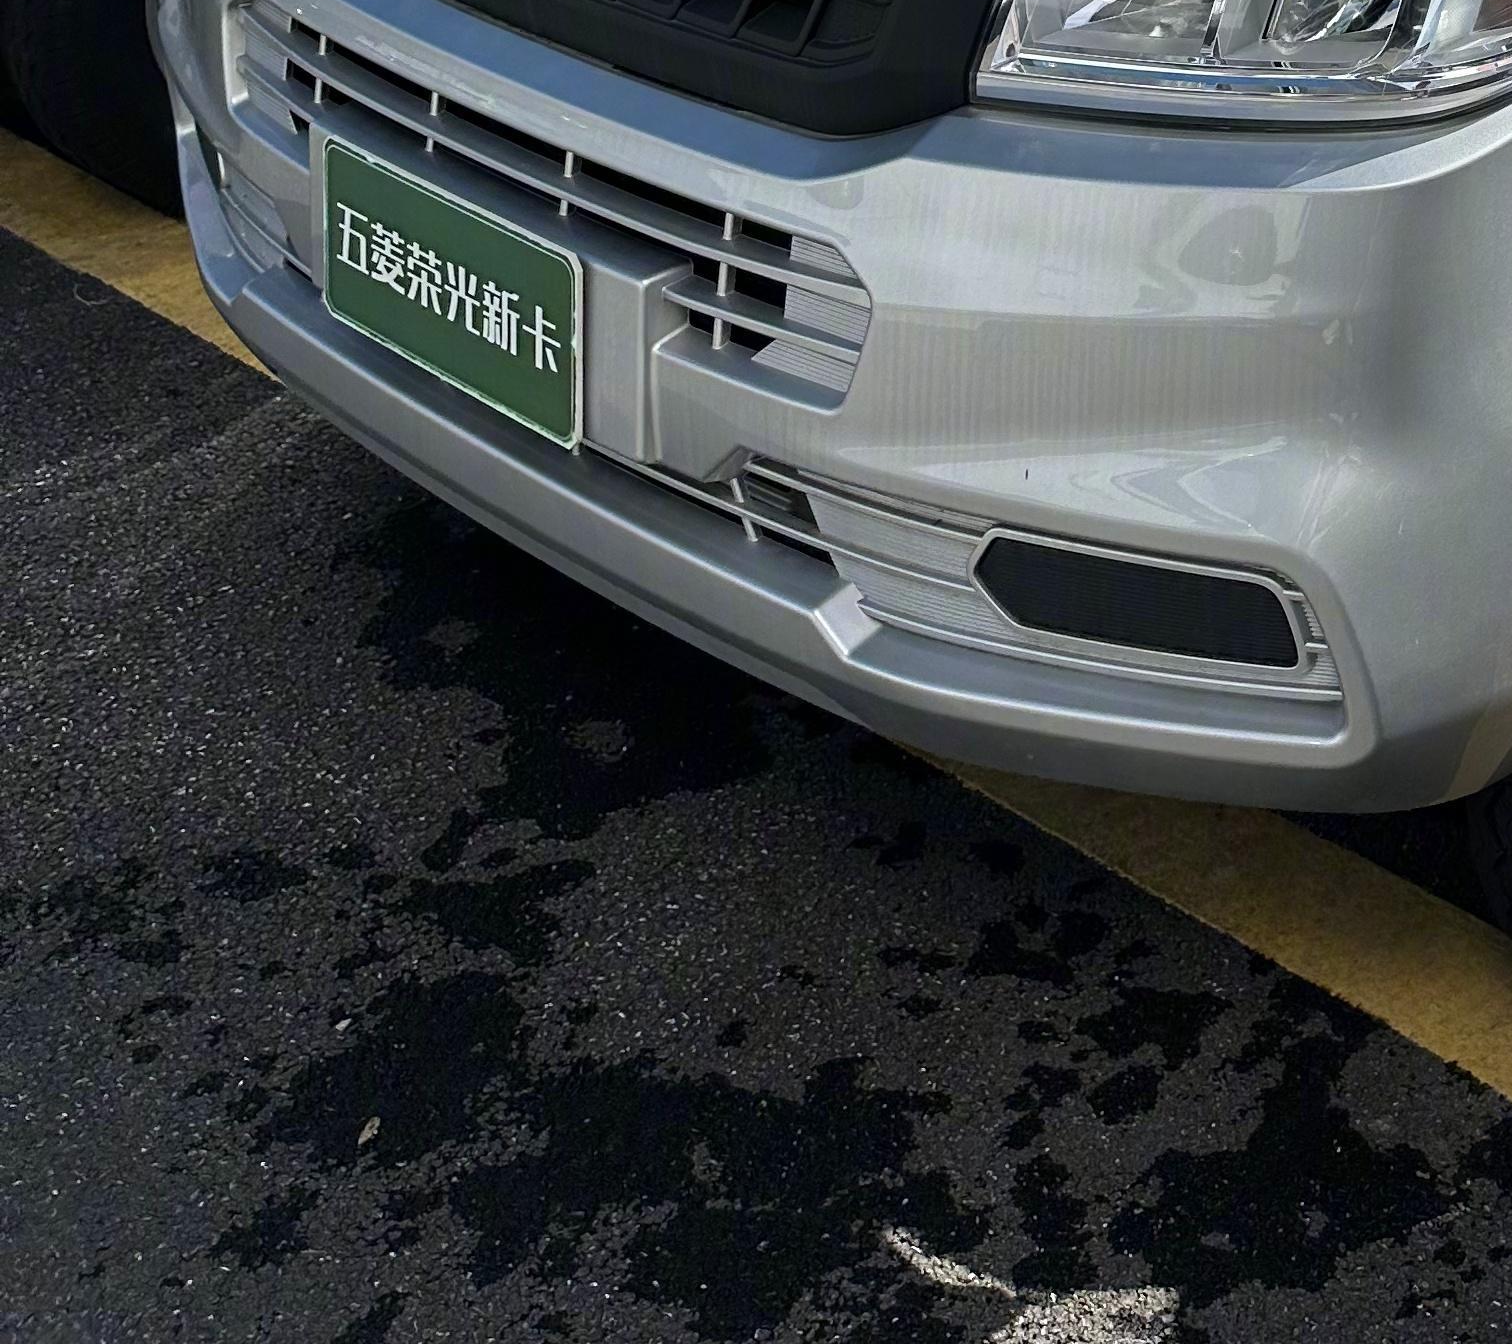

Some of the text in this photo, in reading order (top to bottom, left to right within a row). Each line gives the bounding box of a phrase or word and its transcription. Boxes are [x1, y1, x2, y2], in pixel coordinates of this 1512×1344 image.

[335, 201, 562, 374] 五菱荣光新卡
